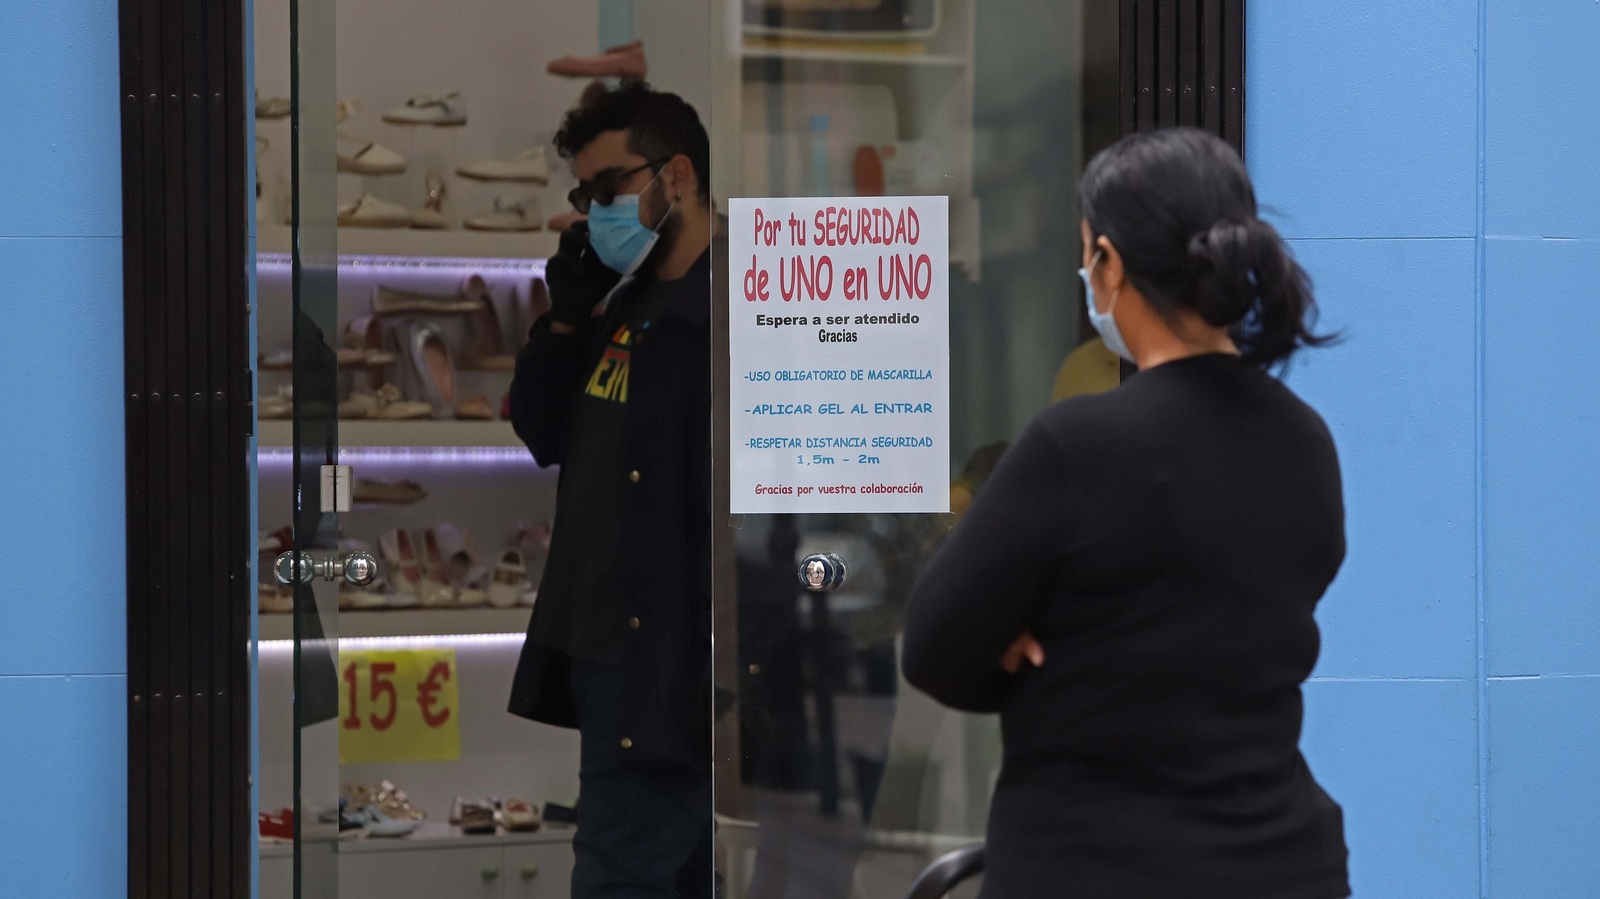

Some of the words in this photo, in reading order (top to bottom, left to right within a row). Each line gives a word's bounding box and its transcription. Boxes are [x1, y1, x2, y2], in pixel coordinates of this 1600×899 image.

[755, 208, 781, 246] Por
[789, 212, 806, 246] tu
[814, 206, 920, 246] SEGURIDAD
[744, 254, 769, 301] de
[780, 255, 833, 302] UNO
[843, 267, 868, 301] en
[879, 253, 932, 301] UNO
[756, 314, 808, 328] Espera
[813, 316, 821, 325] a
[826, 315, 850, 324] ser
[855, 313, 920, 324] atendido
[819, 329, 857, 342] Gracias
[775, 370, 846, 381] OBLIGATORIO
[851, 370, 863, 380] DE
[868, 370, 932, 380] MASCARILLA
[818, 404, 844, 414] GEL
[851, 404, 868, 414] AL
[875, 403, 932, 414] ENTRAR
[806, 438, 867, 448] DISTANCIA
[872, 437, 933, 447] SEGURIDAD
[858, 454, 880, 464] 2m
[755, 484, 793, 494] Gracias
[797, 485, 813, 497] por
[818, 484, 856, 494] vuestra
[860, 482, 923, 493] colaboración
[343, 662, 397, 732] 15
[417, 662, 450, 728] €
